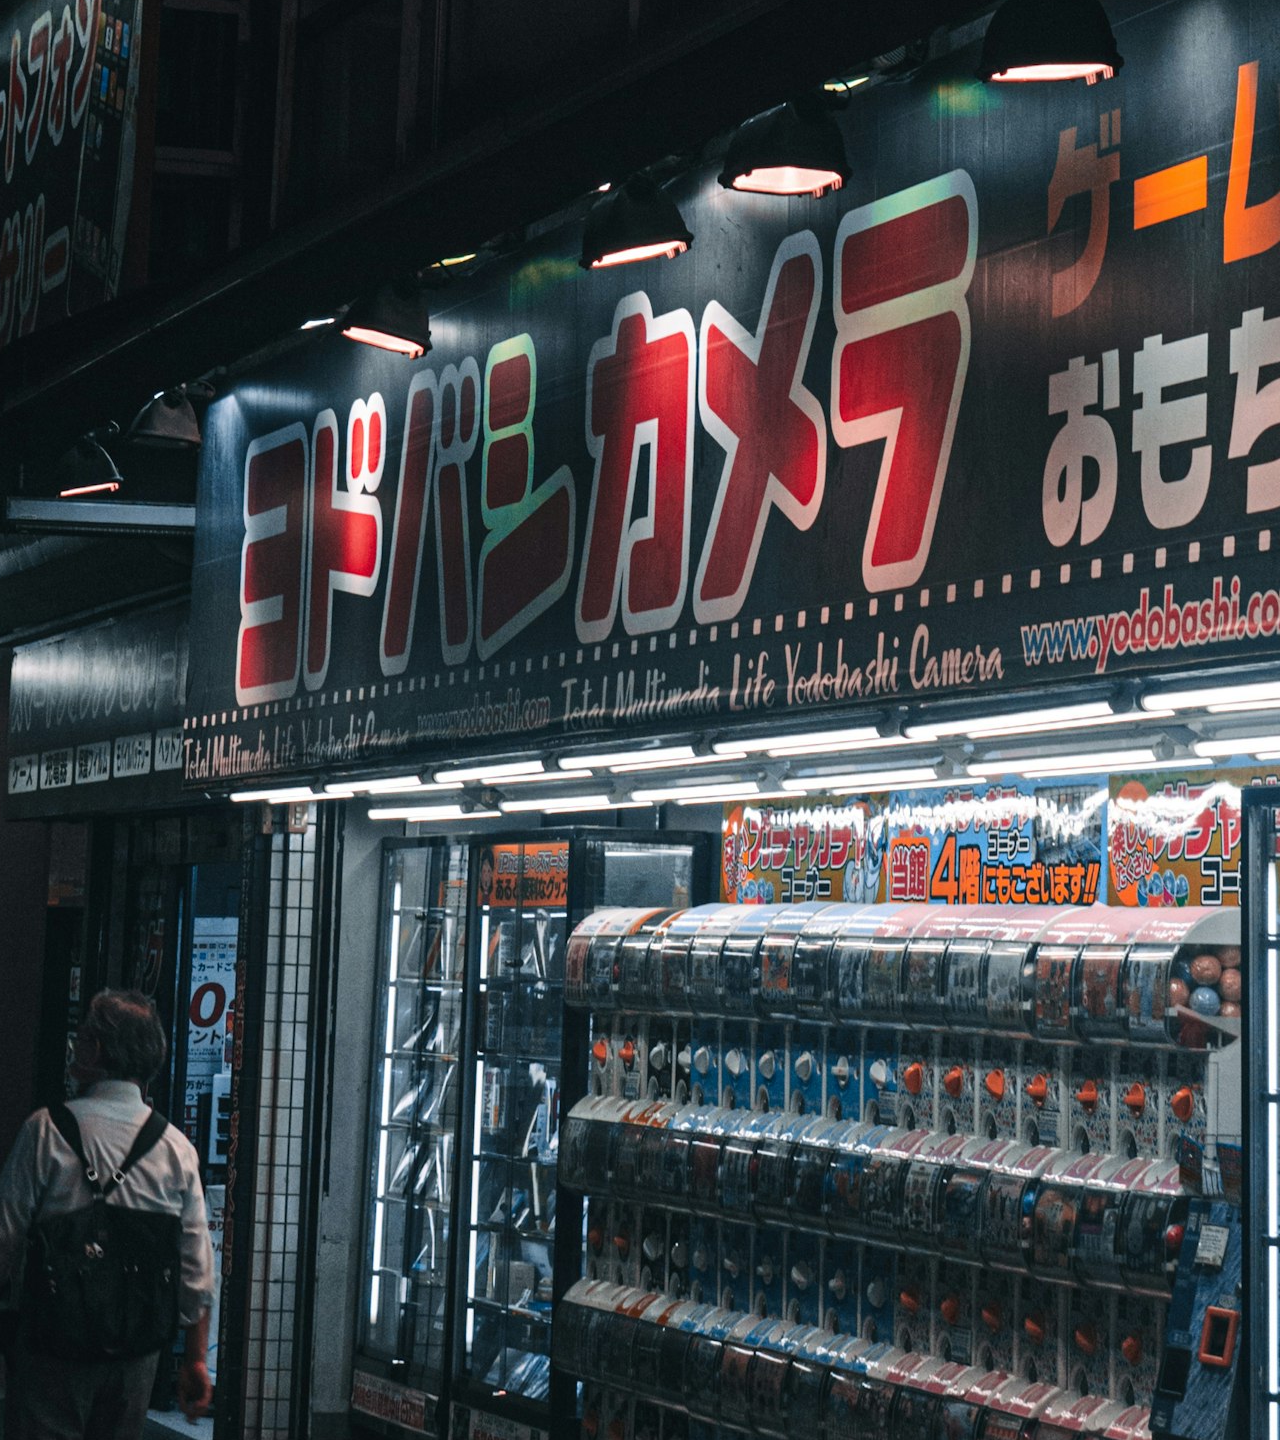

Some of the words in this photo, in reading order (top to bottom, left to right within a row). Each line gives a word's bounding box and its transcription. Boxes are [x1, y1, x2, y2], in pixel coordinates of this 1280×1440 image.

[234, 168, 979, 708] ヨドバシカメラ
[561, 675, 607, 733] Total
[615, 660, 721, 726] Multimedia
[729, 651, 775, 711] Life
[785, 631, 900, 706] Yodobashi
[909, 623, 1006, 690] Camera
[184, 737, 211, 780] Total
[212, 728, 270, 776] Multimedia
[273, 724, 296, 770] Life
[302, 713, 361, 765] Yodobashi
[363, 710, 409, 753] Camera
[891, 844, 928, 901] 当館
[987, 829, 1030, 860] コーナー
[780, 866, 832, 903] コーナー
